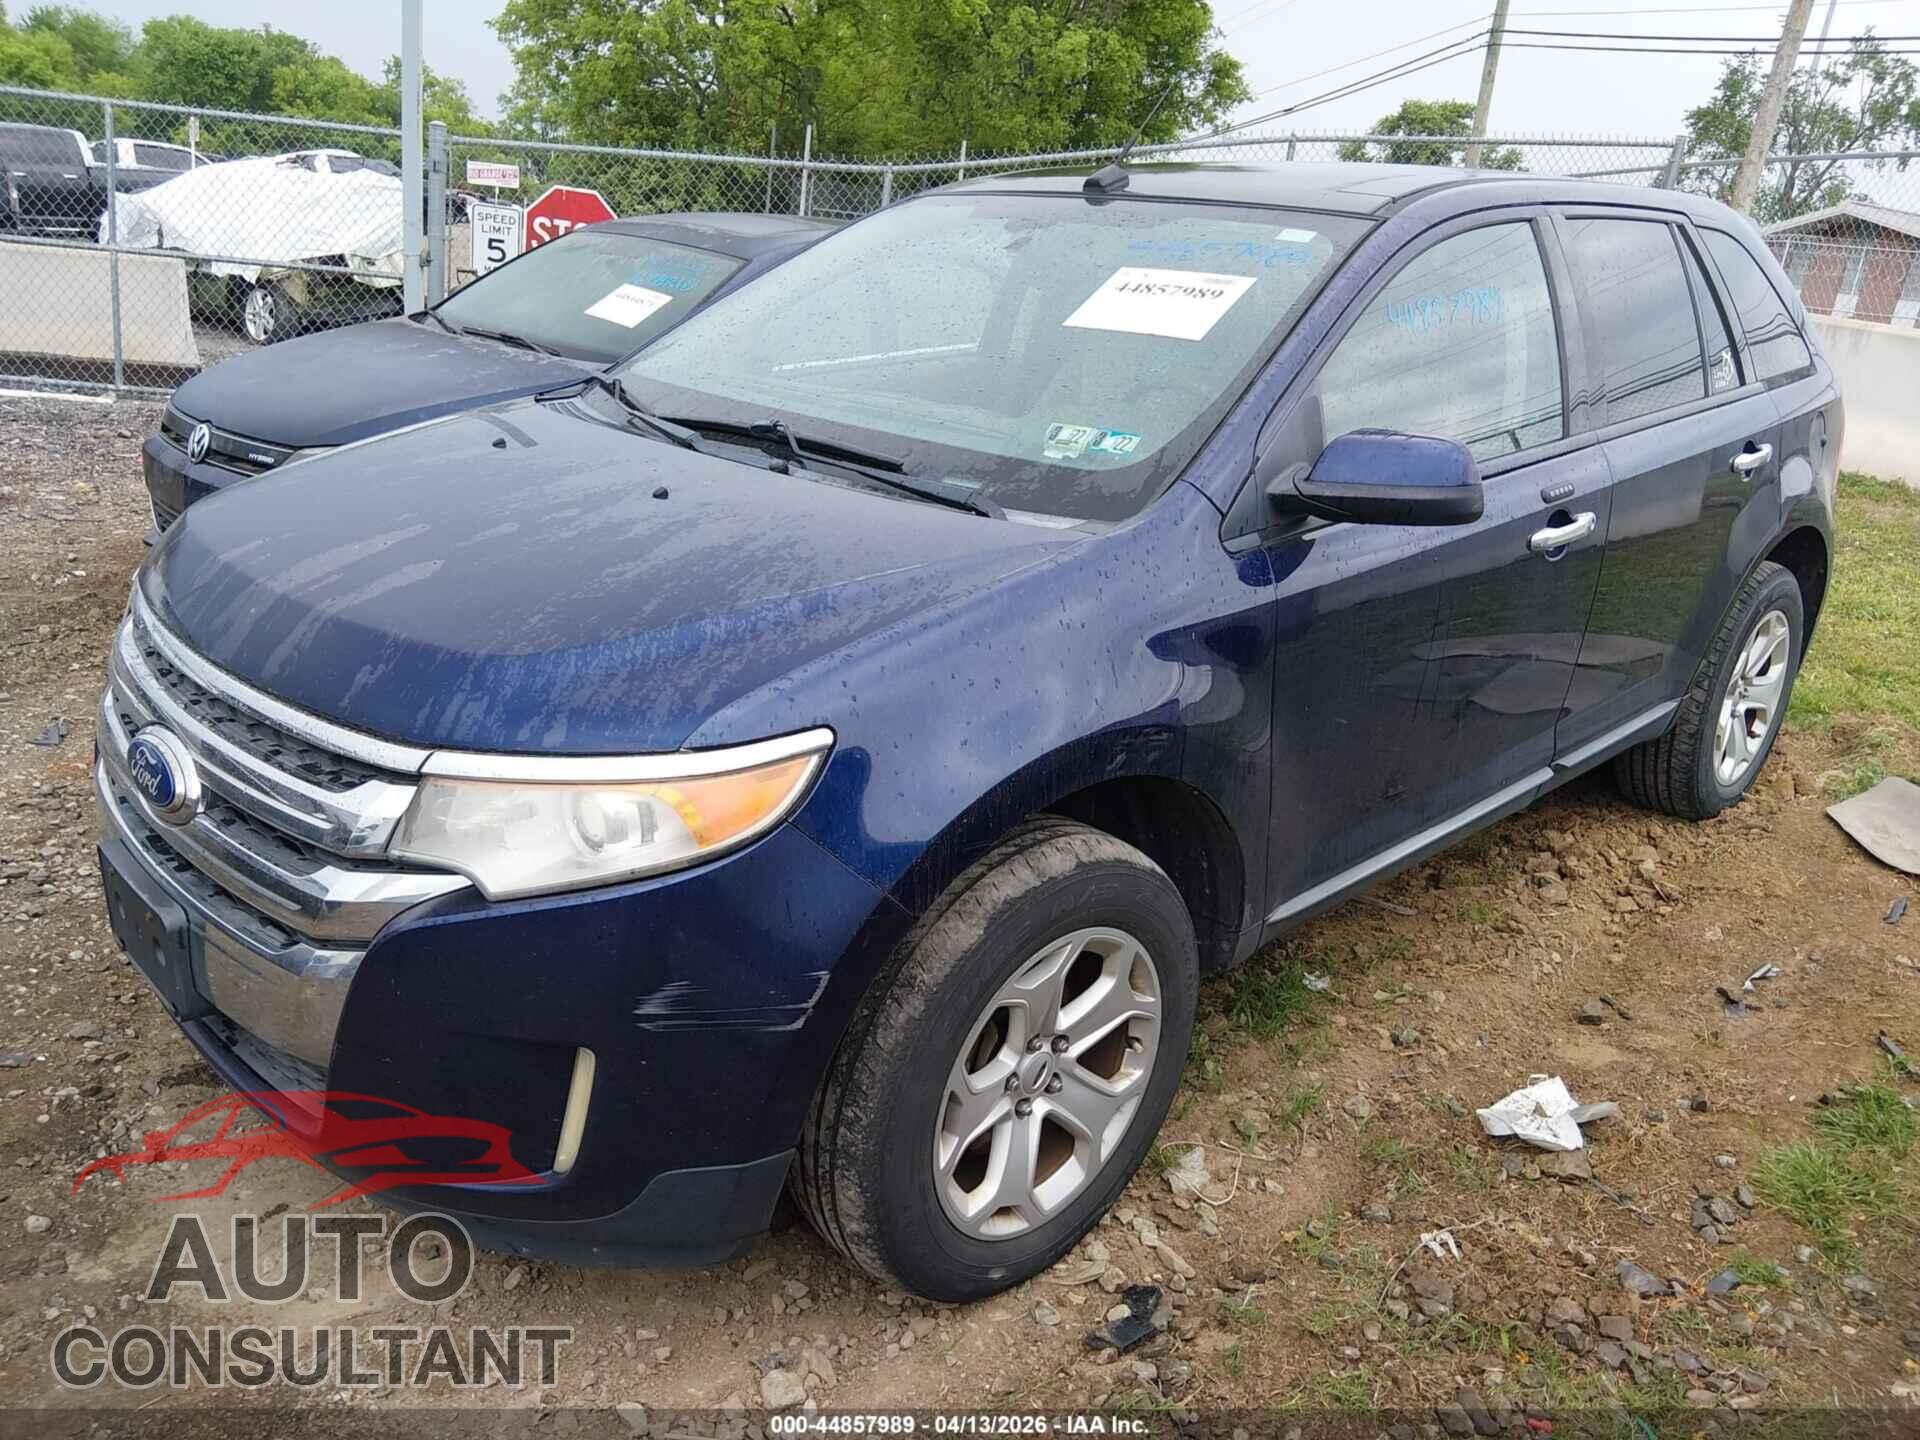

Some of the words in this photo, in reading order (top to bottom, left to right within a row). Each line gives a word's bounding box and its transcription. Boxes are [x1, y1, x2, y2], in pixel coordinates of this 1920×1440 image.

[477, 211, 516, 226] SPEED
[481, 224, 512, 236] LIMIT
[531, 215, 588, 248] ST
[487, 237, 507, 263] 5
[1114, 280, 1225, 300] 44857989
[131, 746, 162, 796] Ford
